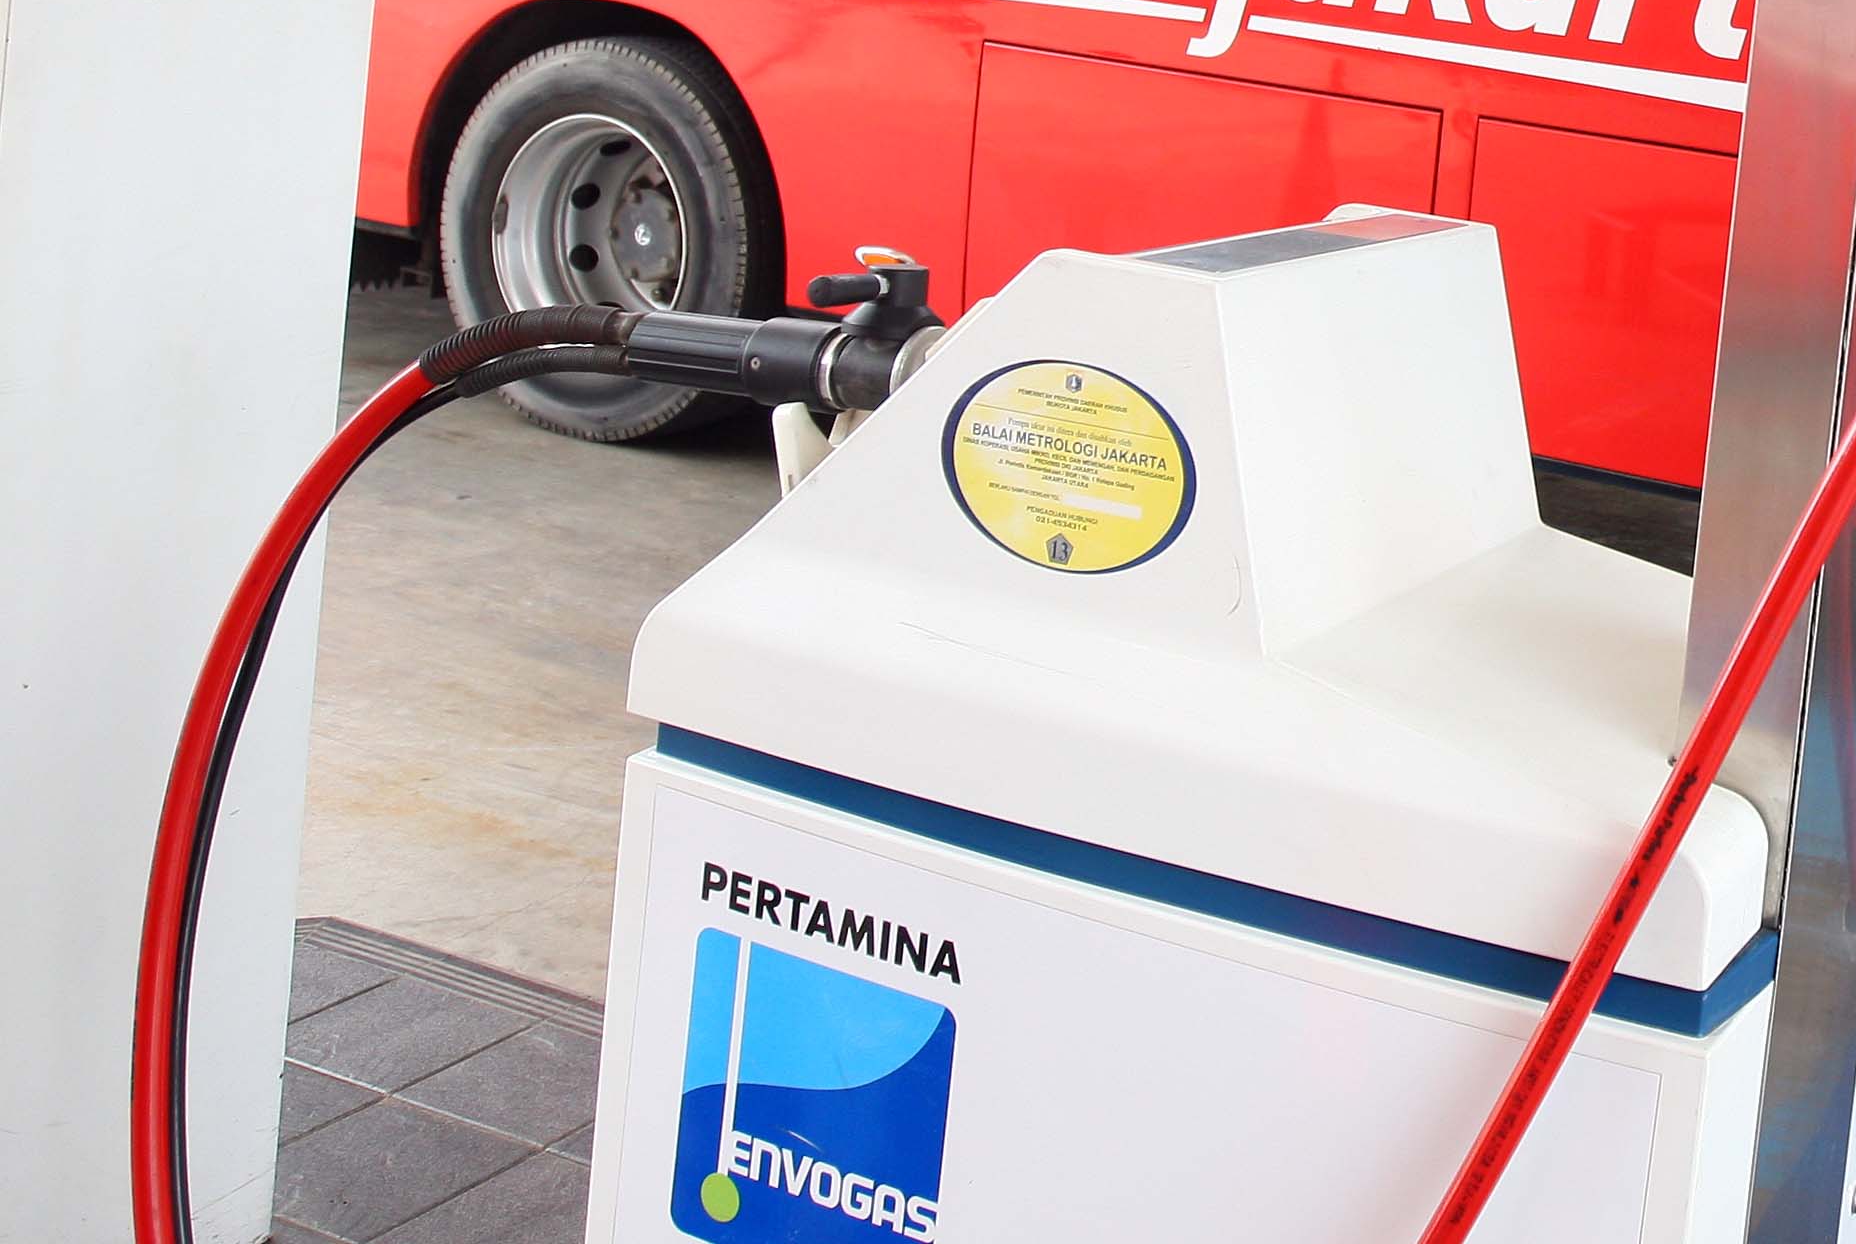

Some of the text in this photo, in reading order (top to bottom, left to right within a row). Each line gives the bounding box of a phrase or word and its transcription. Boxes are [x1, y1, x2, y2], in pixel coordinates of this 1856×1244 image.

[972, 422, 1168, 470] BALAI METROLOGI JAKARTA
[1042, 474, 1067, 484] JAKARTA
[1073, 464, 1098, 474] JAKARTA
[1052, 540, 1069, 562] 13
[700, 861, 962, 985] PERTAMINA
[727, 1128, 940, 1244] ENVOGAS
